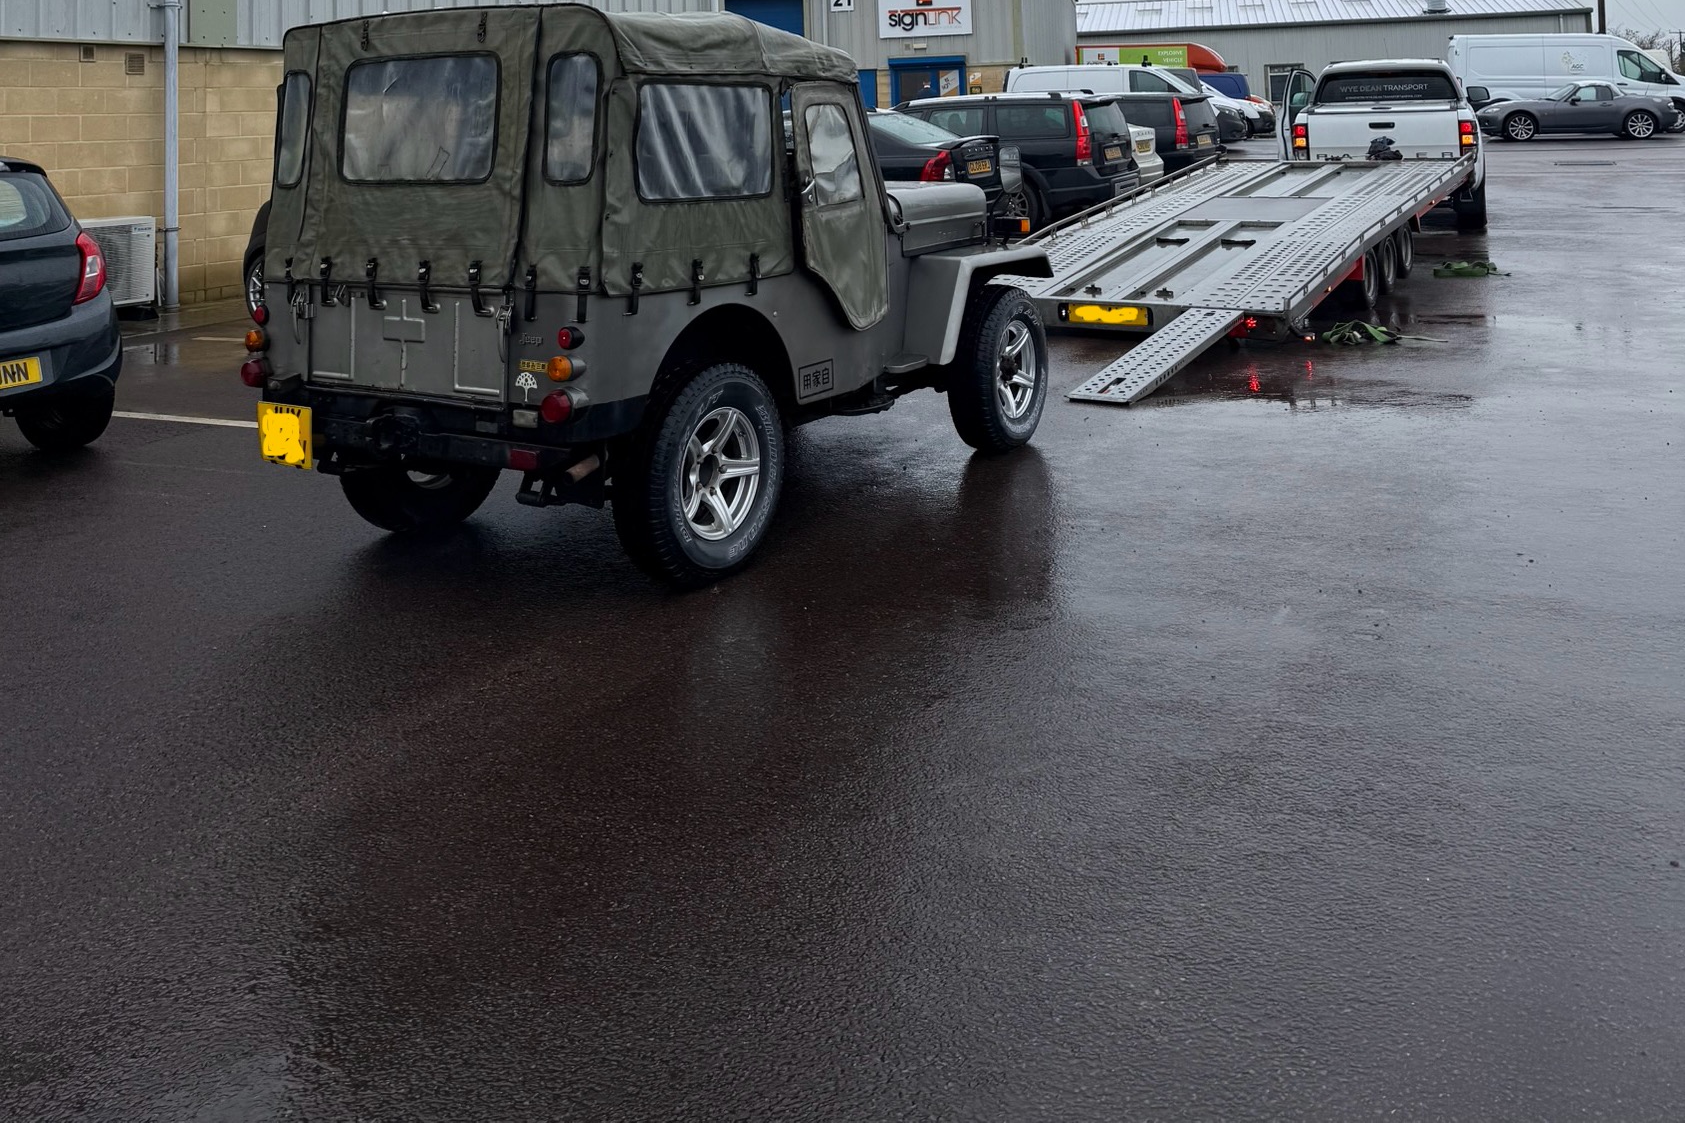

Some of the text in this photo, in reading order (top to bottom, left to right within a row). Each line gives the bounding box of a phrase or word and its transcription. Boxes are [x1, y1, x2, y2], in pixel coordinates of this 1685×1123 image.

[1340, 83, 1428, 93] WYE DEAN TRANSPORT
[519, 332, 543, 347] Jeep
